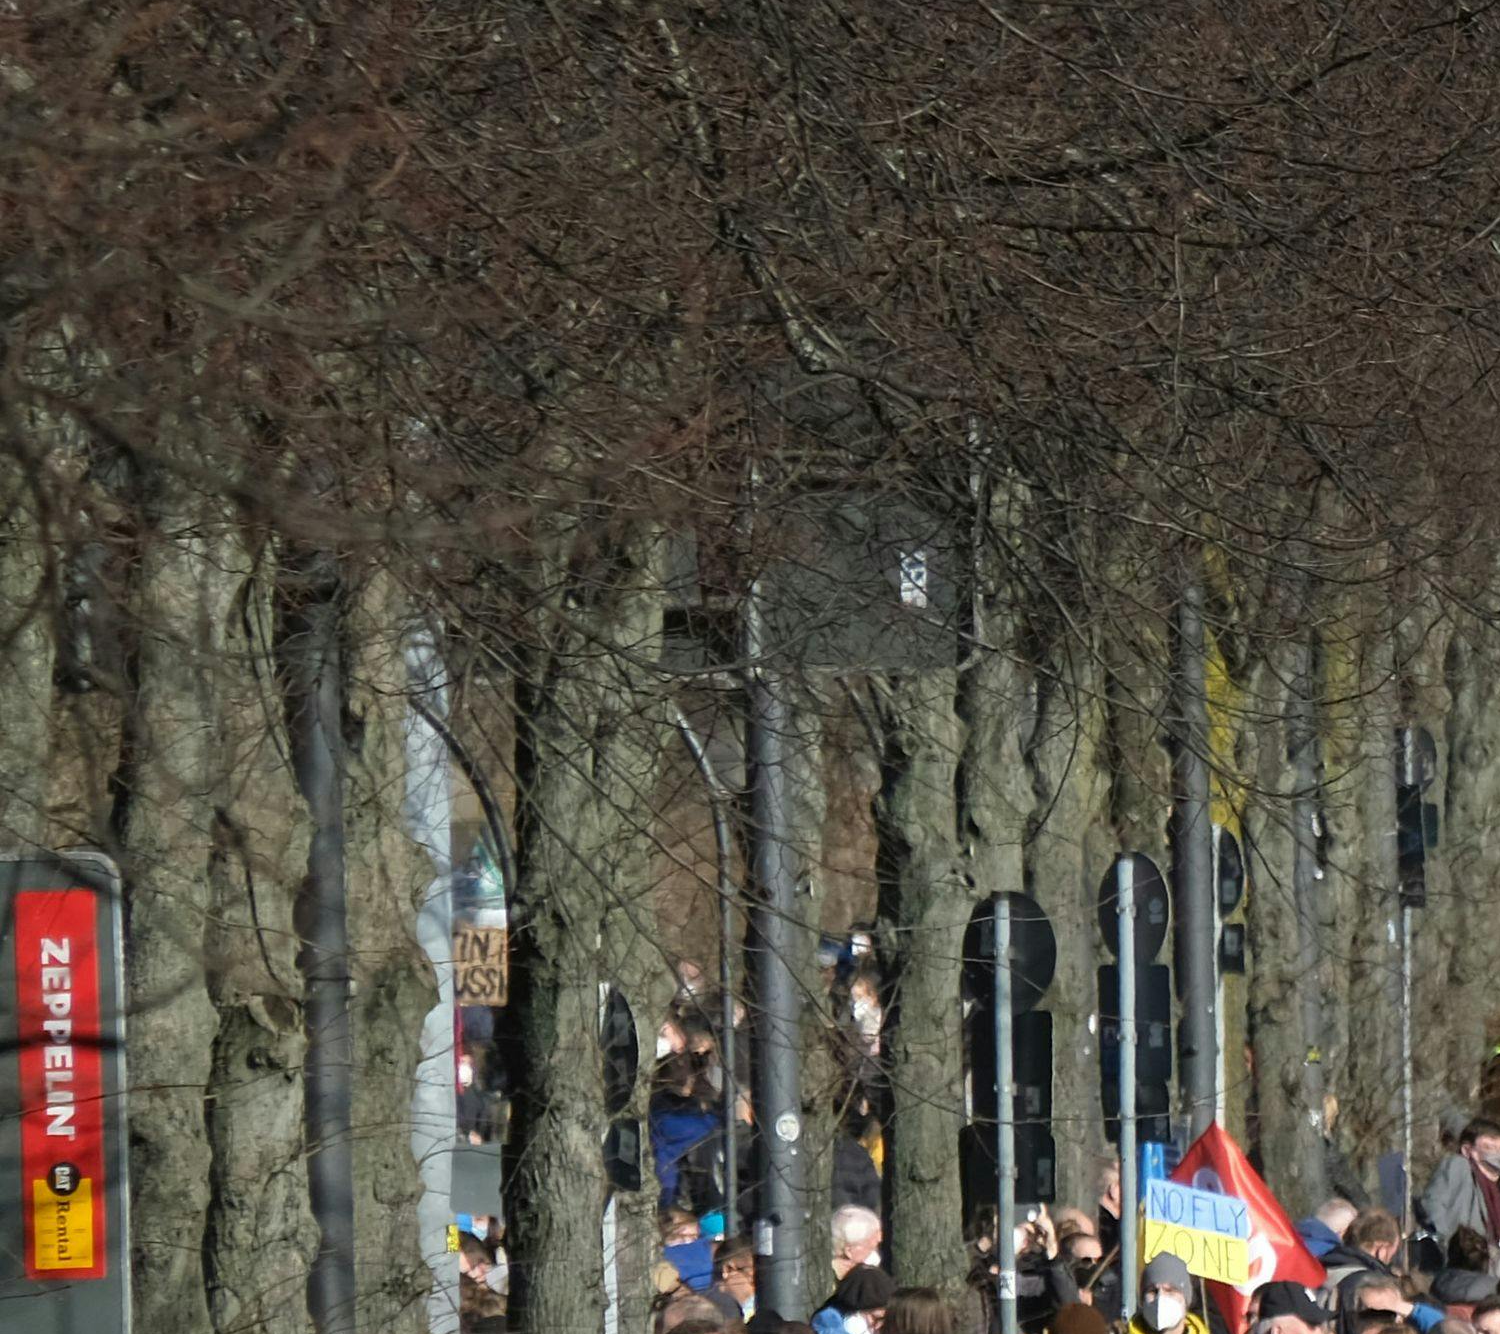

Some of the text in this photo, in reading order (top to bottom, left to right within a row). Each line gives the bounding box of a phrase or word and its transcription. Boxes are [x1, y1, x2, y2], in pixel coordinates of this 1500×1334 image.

[41, 938, 75, 1137] ZEPPELIN
[54, 1166, 70, 1190] CAT
[55, 1200, 71, 1262] Rental
[1150, 1184, 1247, 1239] NO FLY
[1150, 1222, 1243, 1283] ZONE
